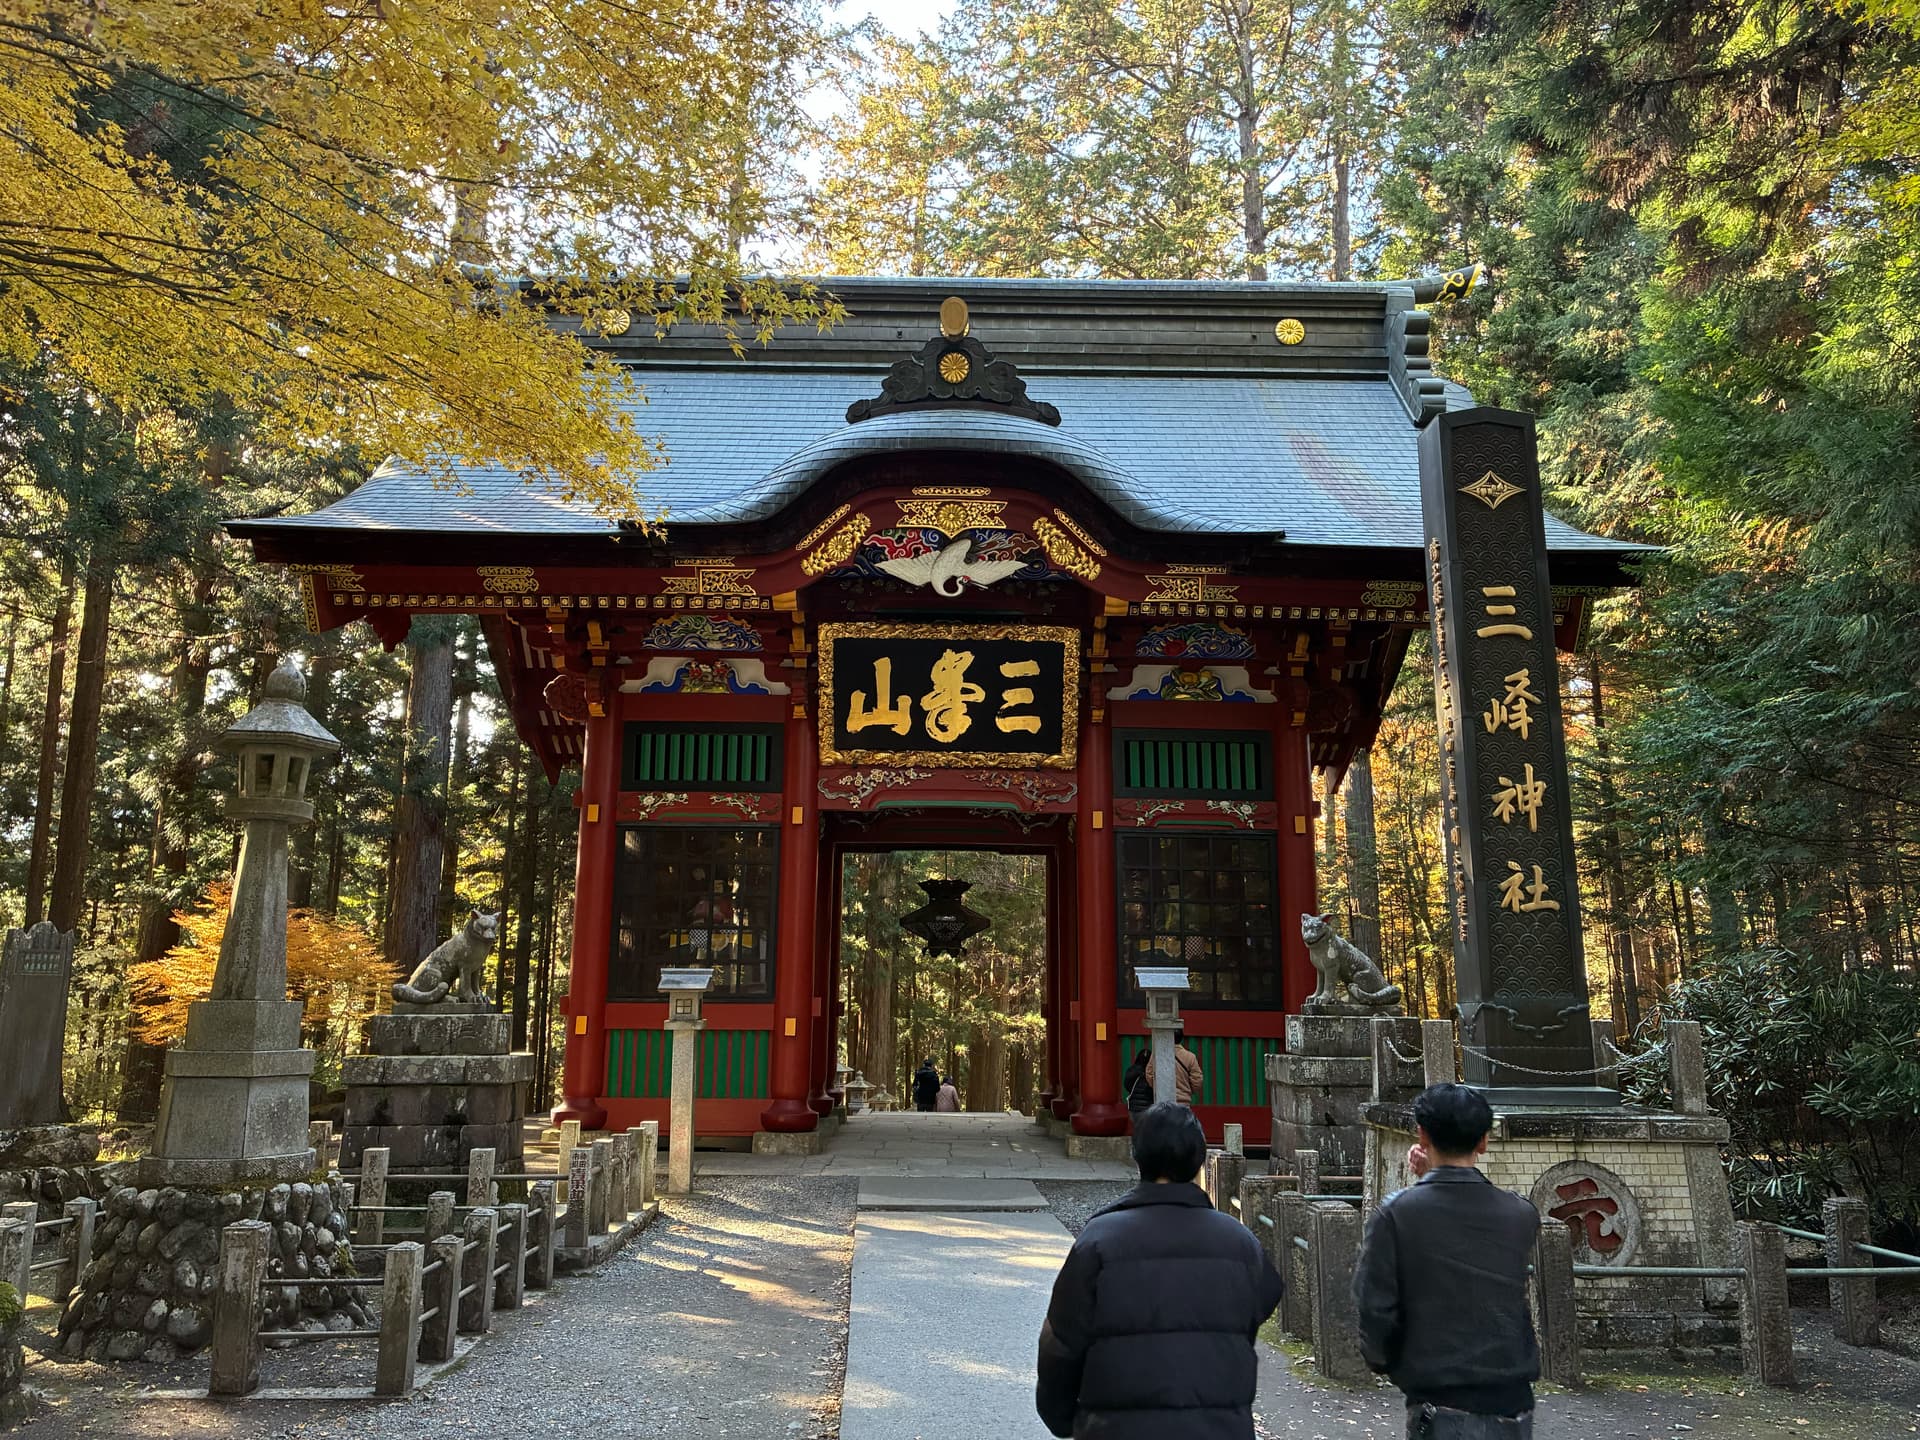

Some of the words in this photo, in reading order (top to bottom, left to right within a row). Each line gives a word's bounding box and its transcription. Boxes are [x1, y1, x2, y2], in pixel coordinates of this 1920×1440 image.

[1476, 585, 1560, 914] 三峰神社
[1548, 1178, 1622, 1254] 元
